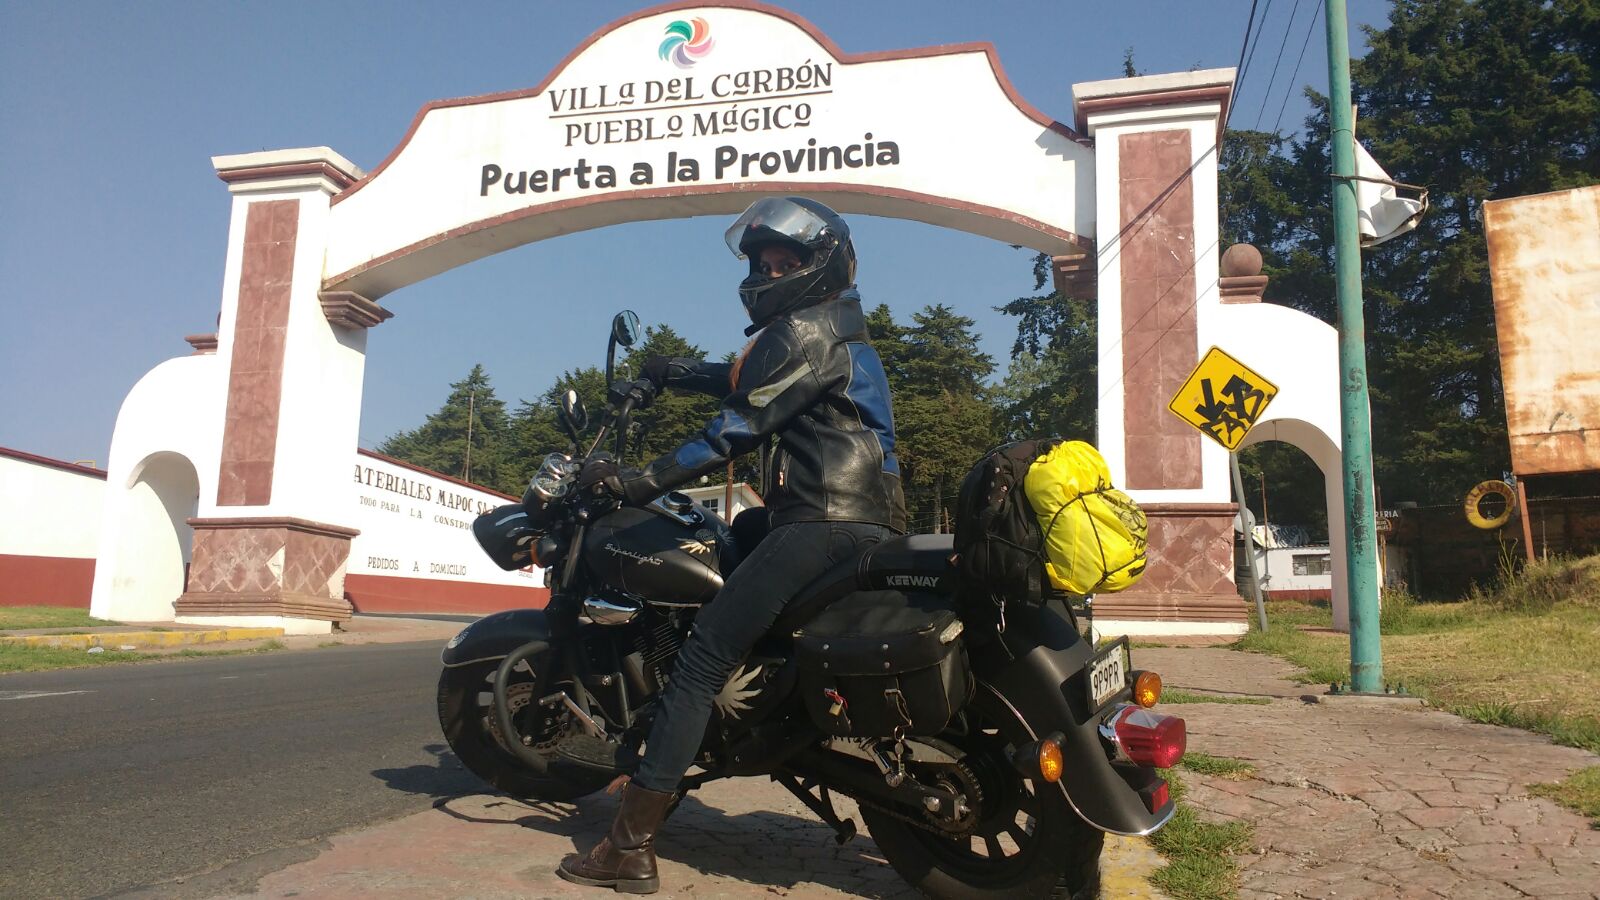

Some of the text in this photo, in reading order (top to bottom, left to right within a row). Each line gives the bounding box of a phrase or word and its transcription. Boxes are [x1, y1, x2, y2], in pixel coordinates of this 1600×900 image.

[480, 132, 900, 197] Puerta a la Provincia
[359, 495, 377, 507] TODO
[380, 500, 401, 513] PARA
[410, 507, 423, 519] LA
[435, 489, 474, 513] MAPOC
[367, 556, 467, 576] PEDIDOS A DOMICILIO
[885, 575, 940, 588] KEEWAY
[1093, 660, 1120, 699] 9P9PR
